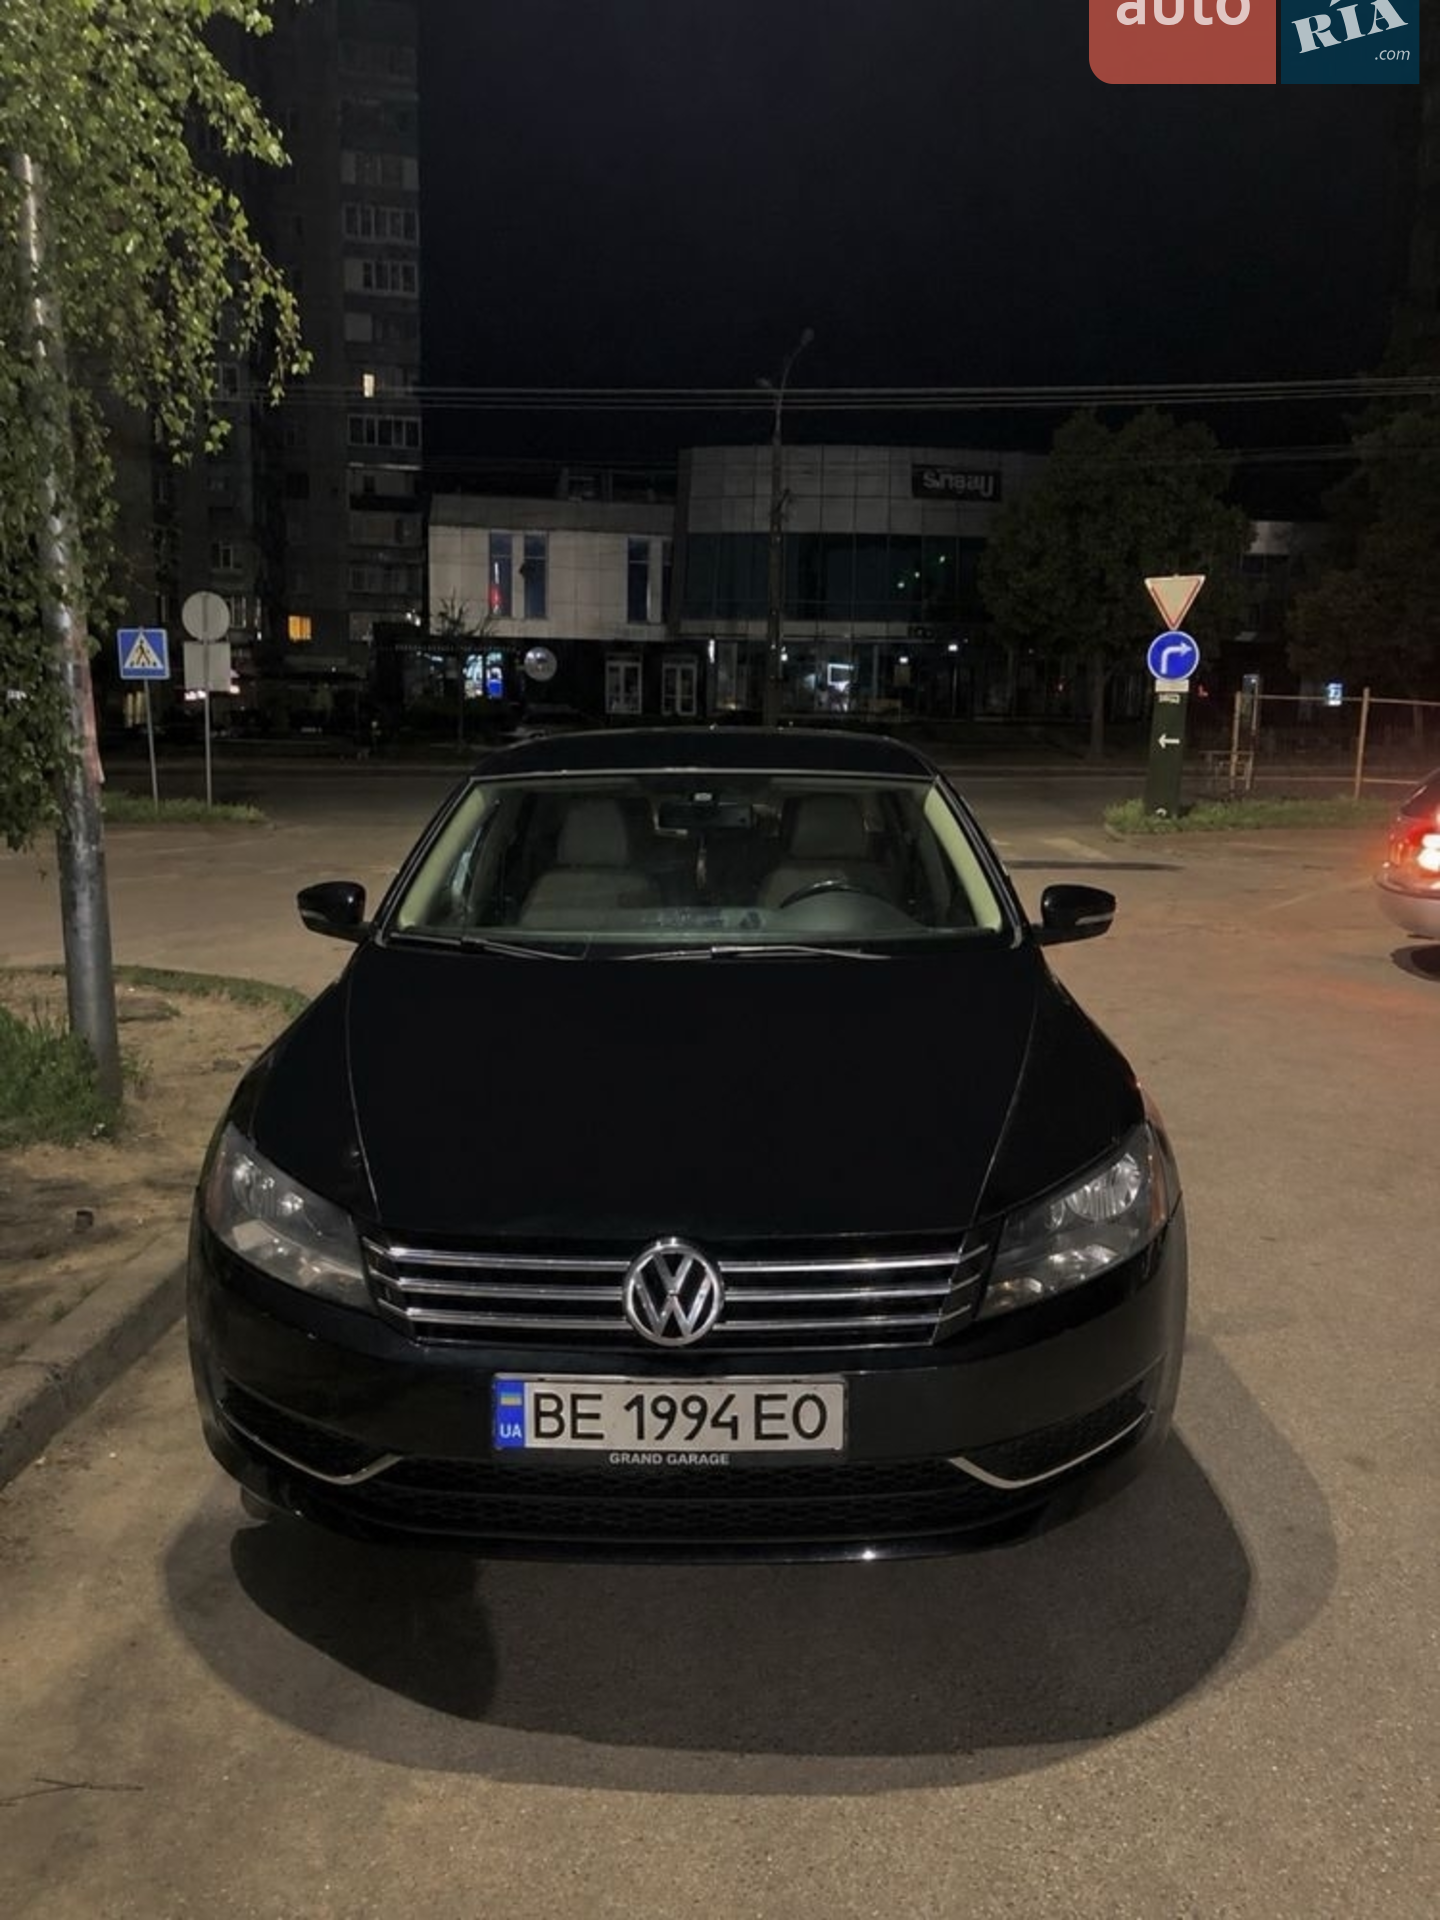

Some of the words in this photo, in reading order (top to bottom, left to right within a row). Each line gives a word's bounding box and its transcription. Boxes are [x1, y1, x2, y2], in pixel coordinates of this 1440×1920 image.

[534, 1393, 604, 1440] BE
[624, 1393, 738, 1440] 1994
[754, 1393, 827, 1440] EO
[500, 1424, 522, 1438] UA
[609, 1453, 663, 1465] GRAND
[667, 1453, 730, 1466] GARAGE
